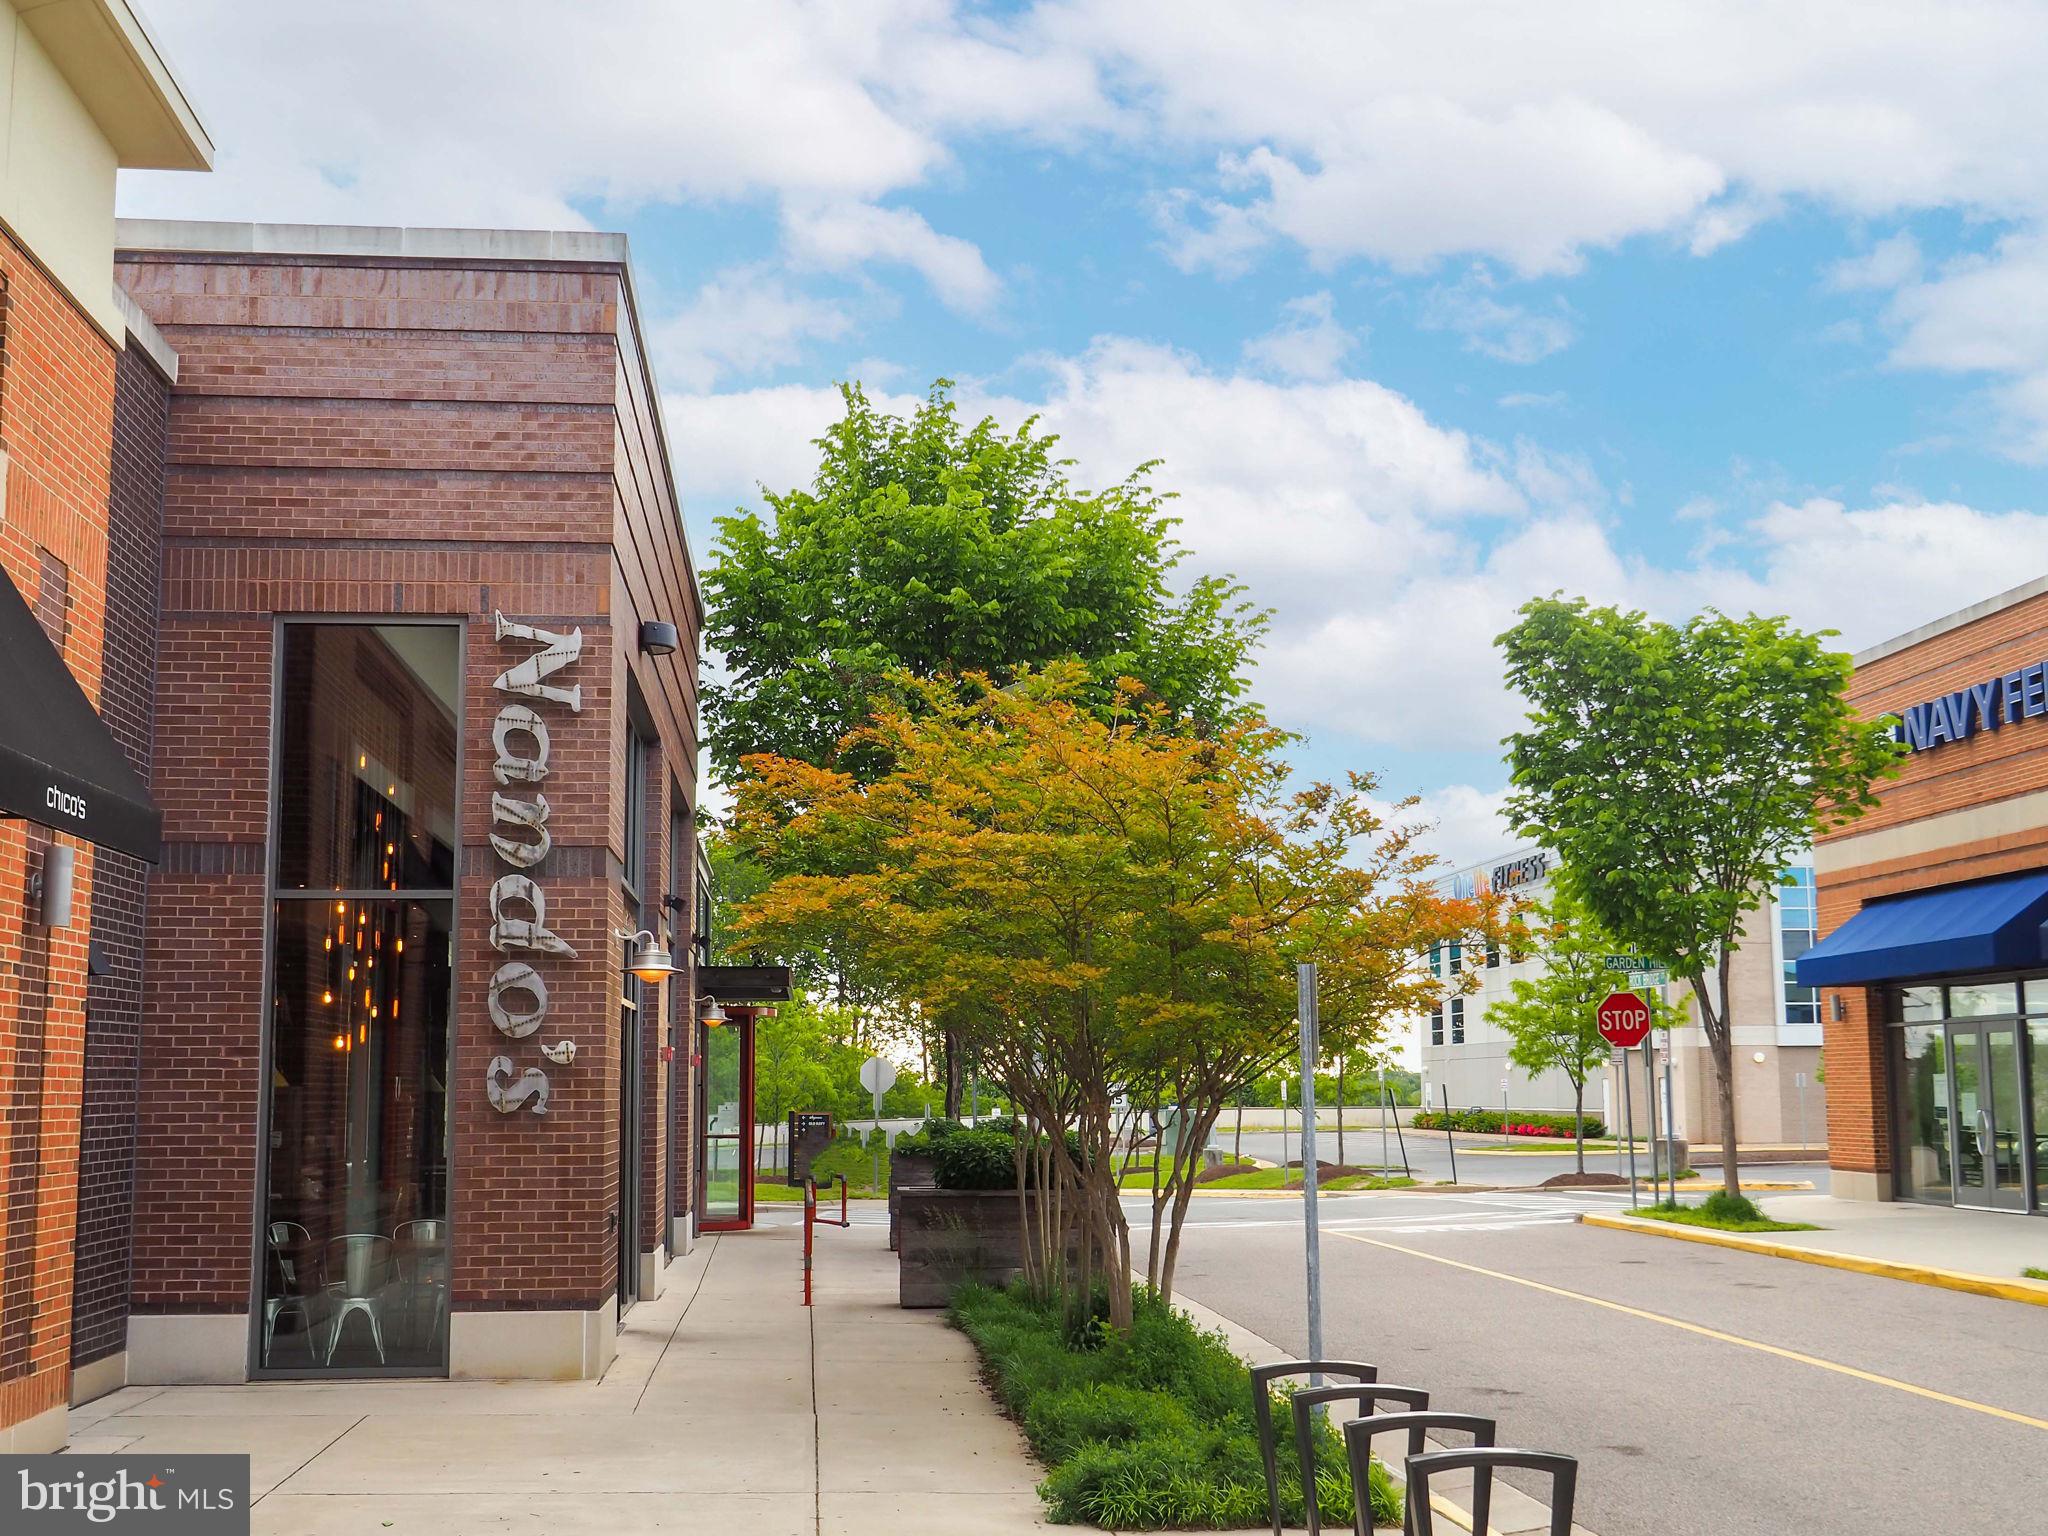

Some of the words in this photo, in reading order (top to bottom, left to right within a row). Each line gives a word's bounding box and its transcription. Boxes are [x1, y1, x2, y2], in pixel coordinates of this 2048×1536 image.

[1903, 677, 2002, 754] NAVY
[46, 785, 86, 819] chico's
[487, 609, 582, 1114] Nando's
[1492, 852, 1545, 895] FITNESS
[1605, 957, 1645, 969] GARDEN
[1601, 1009, 1646, 1032] STOP
